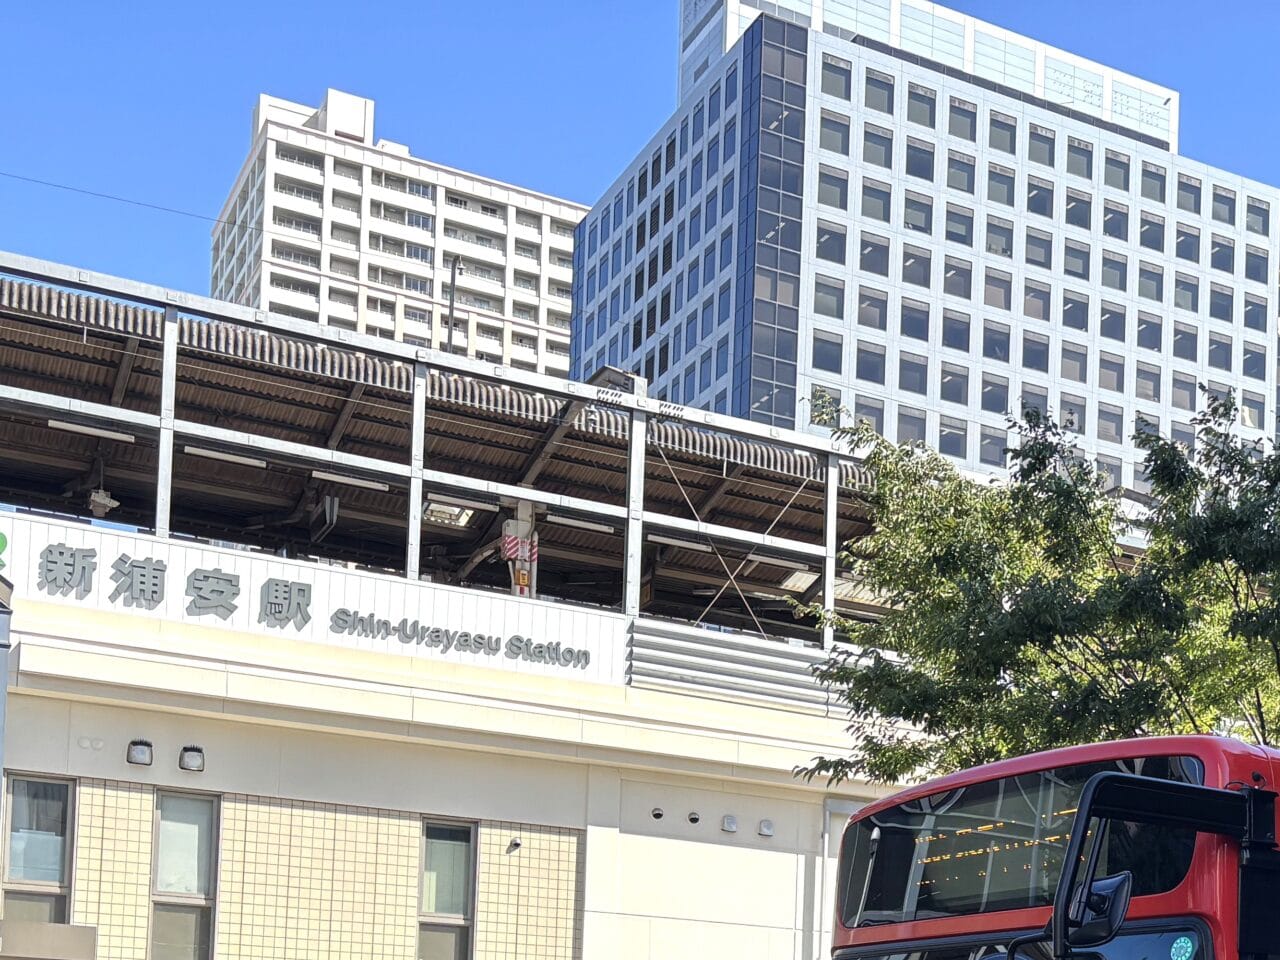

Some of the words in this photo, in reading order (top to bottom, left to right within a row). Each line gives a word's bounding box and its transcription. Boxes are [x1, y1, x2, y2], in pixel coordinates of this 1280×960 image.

[37, 542, 312, 632] 新浦安駅
[330, 608, 501, 654] Shin-Urayasu
[504, 635, 590, 669] Station
